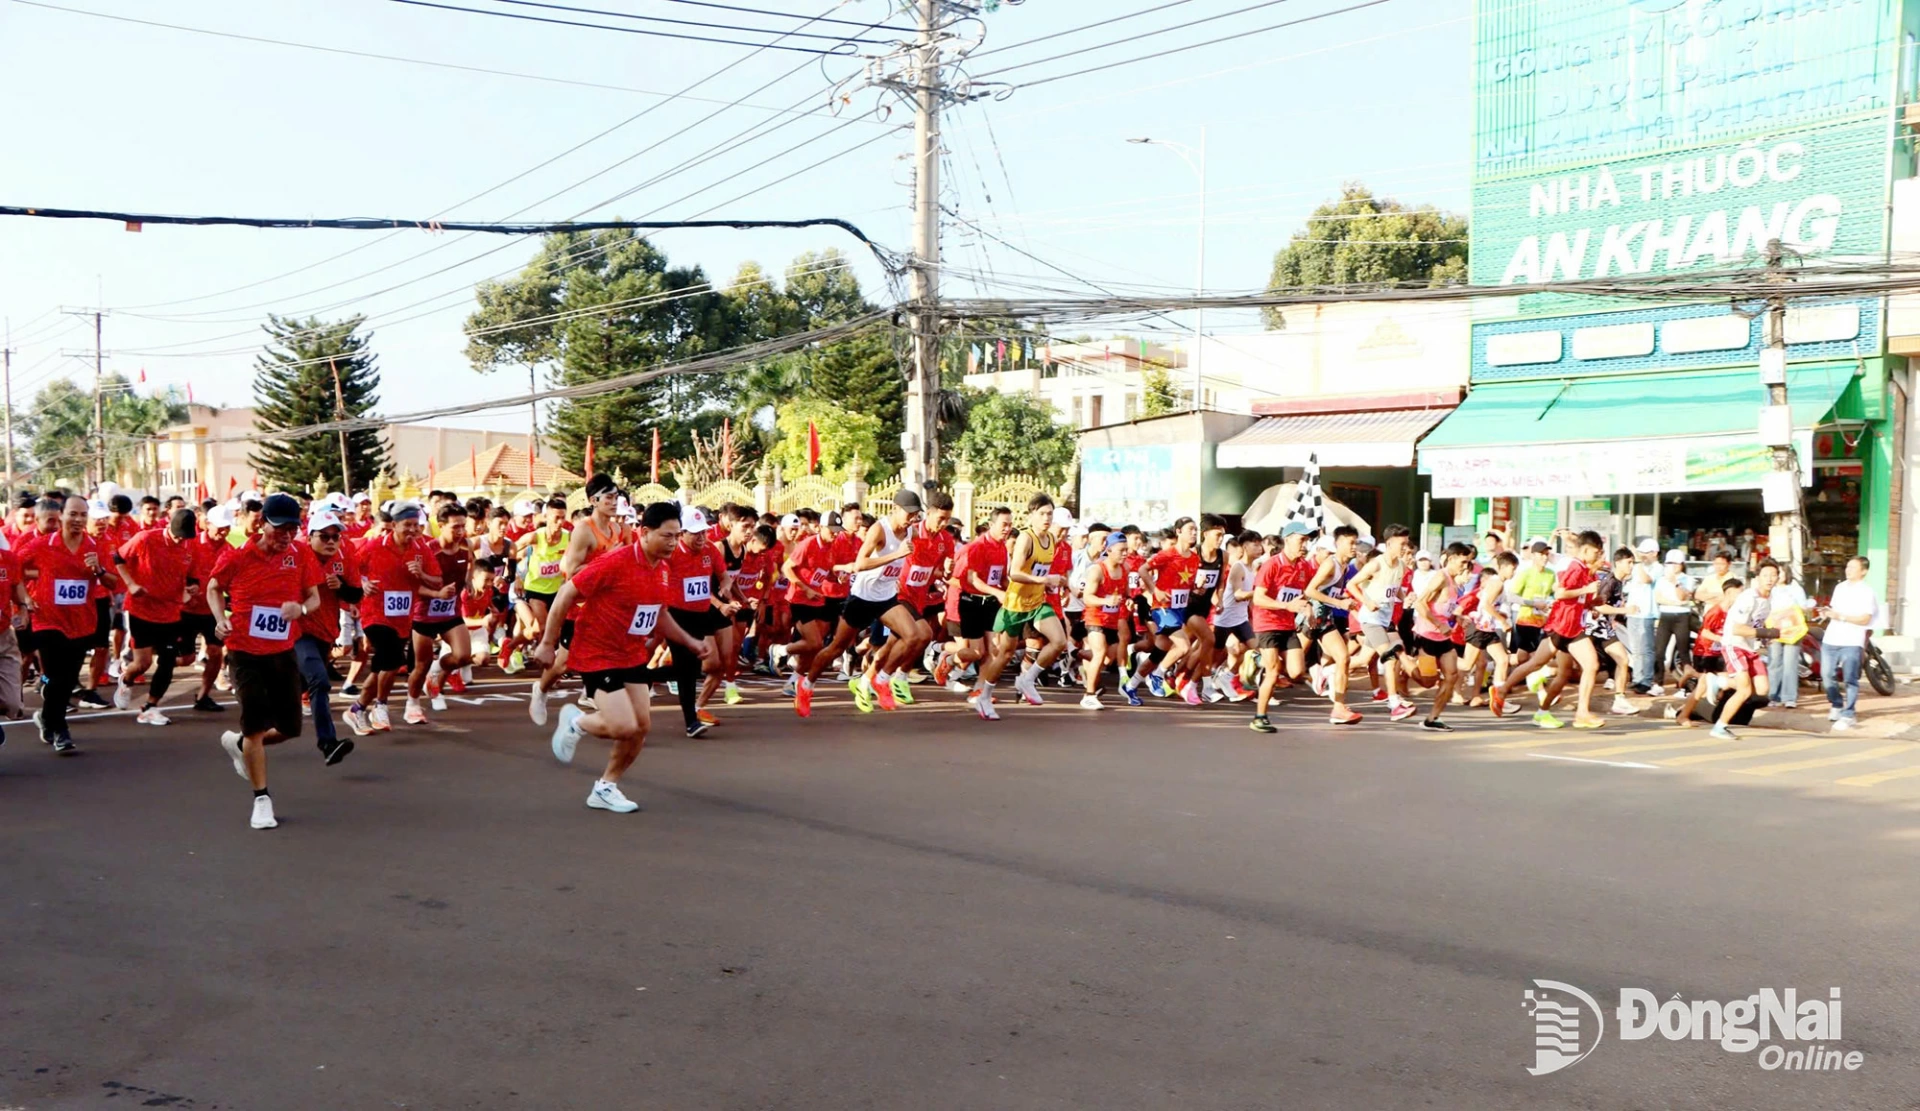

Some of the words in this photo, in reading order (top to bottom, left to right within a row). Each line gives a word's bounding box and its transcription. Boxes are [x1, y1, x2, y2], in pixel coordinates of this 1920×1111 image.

[1528, 164, 1621, 218] NHÀ
[1634, 136, 1804, 202] THUỐC
[1500, 228, 1590, 287] AN
[1594, 193, 1843, 279] KHANG
[541, 564, 560, 575] 020
[58, 585, 86, 599] 468
[688, 581, 708, 596] 478
[388, 596, 409, 611] 380
[255, 613, 288, 633] 489
